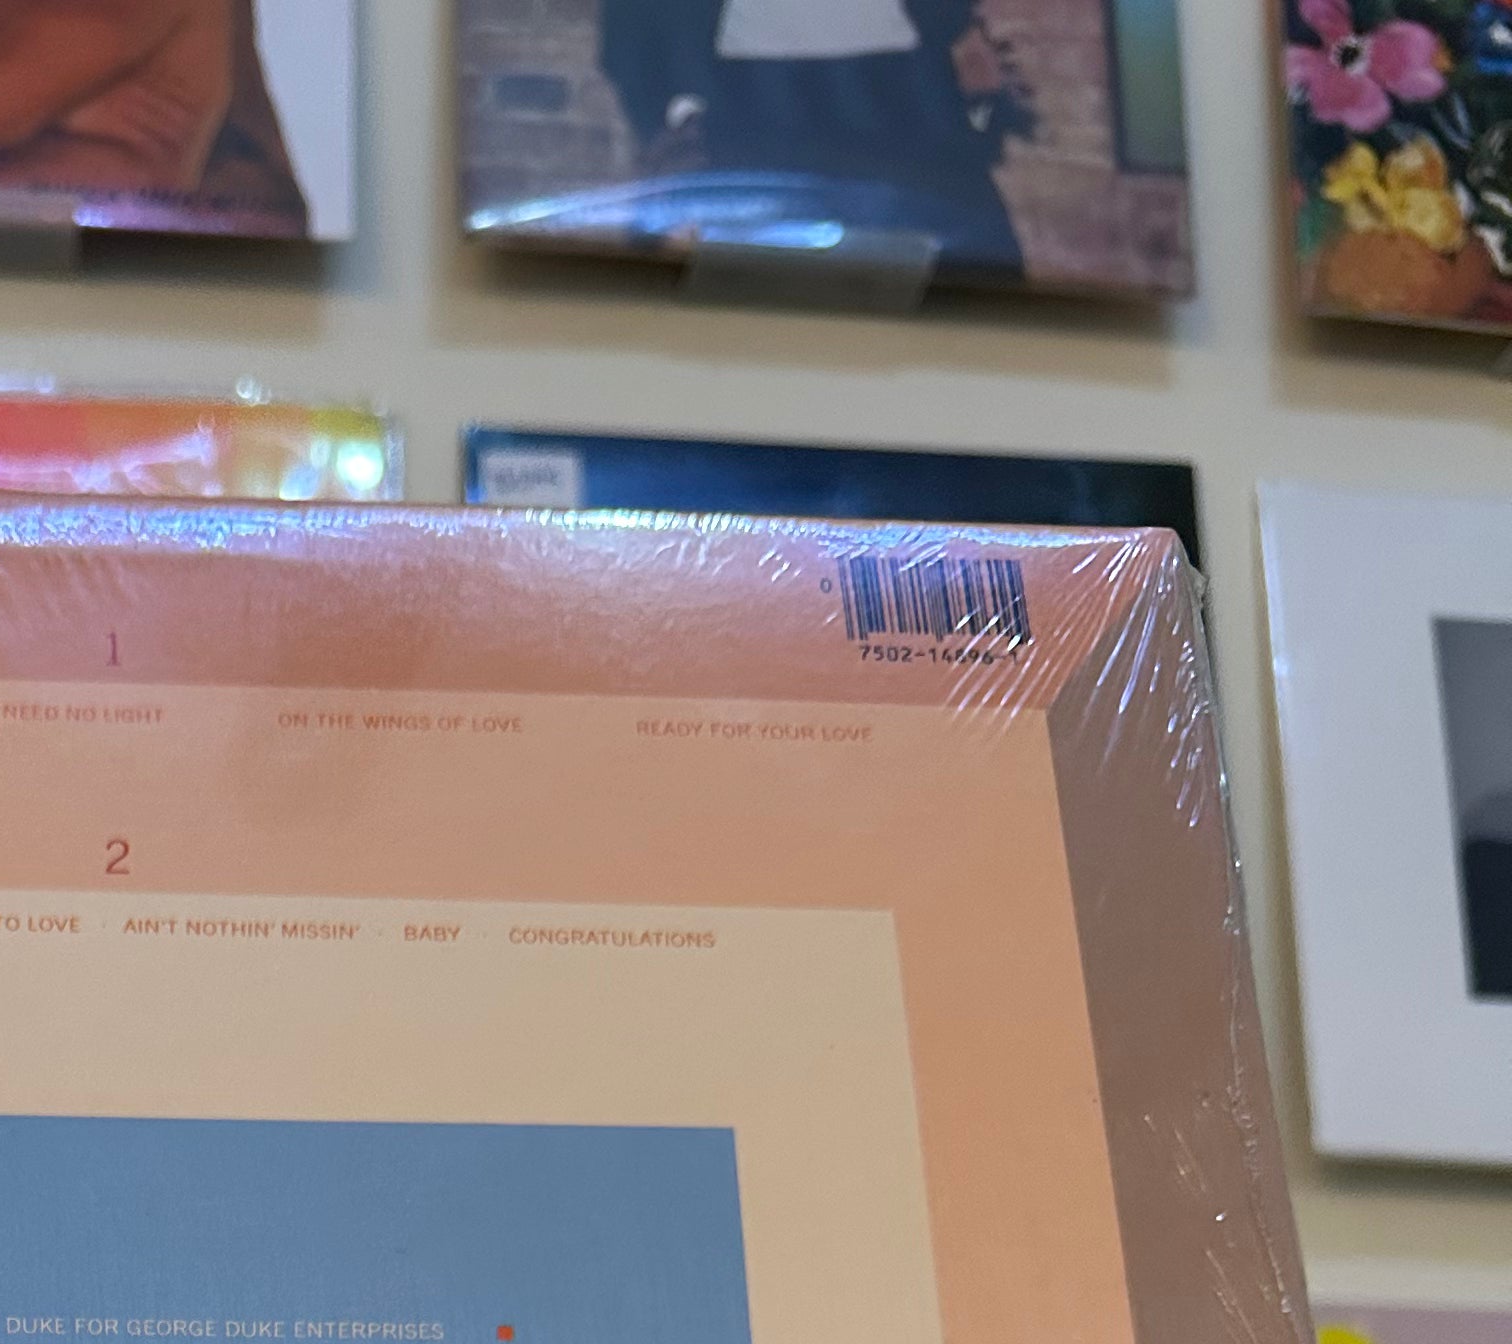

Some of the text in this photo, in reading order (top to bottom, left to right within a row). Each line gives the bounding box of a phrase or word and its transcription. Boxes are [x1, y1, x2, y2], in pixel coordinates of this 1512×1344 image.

[106, 632, 121, 667] 1
[2, 705, 60, 722] NEED
[65, 707, 97, 723] NO
[102, 708, 165, 725] LIGHT
[277, 712, 523, 735] ON THE WINGS OF LOVE
[635, 719, 876, 744] READY FOR YOUR LOVE
[104, 839, 131, 875] 2
[27, 914, 81, 935] LOVE
[123, 917, 361, 941] AIN'T NOTHIN' MISSIN'
[403, 924, 461, 944] BABY
[508, 925, 717, 950] CONGRATULATIONS
[6, 1316, 66, 1336] DUKE
[74, 1317, 119, 1336] FOR
[126, 1319, 217, 1338] GEORGE
[225, 1320, 286, 1339] DUKE
[294, 1320, 445, 1341] ENTERPRISES
